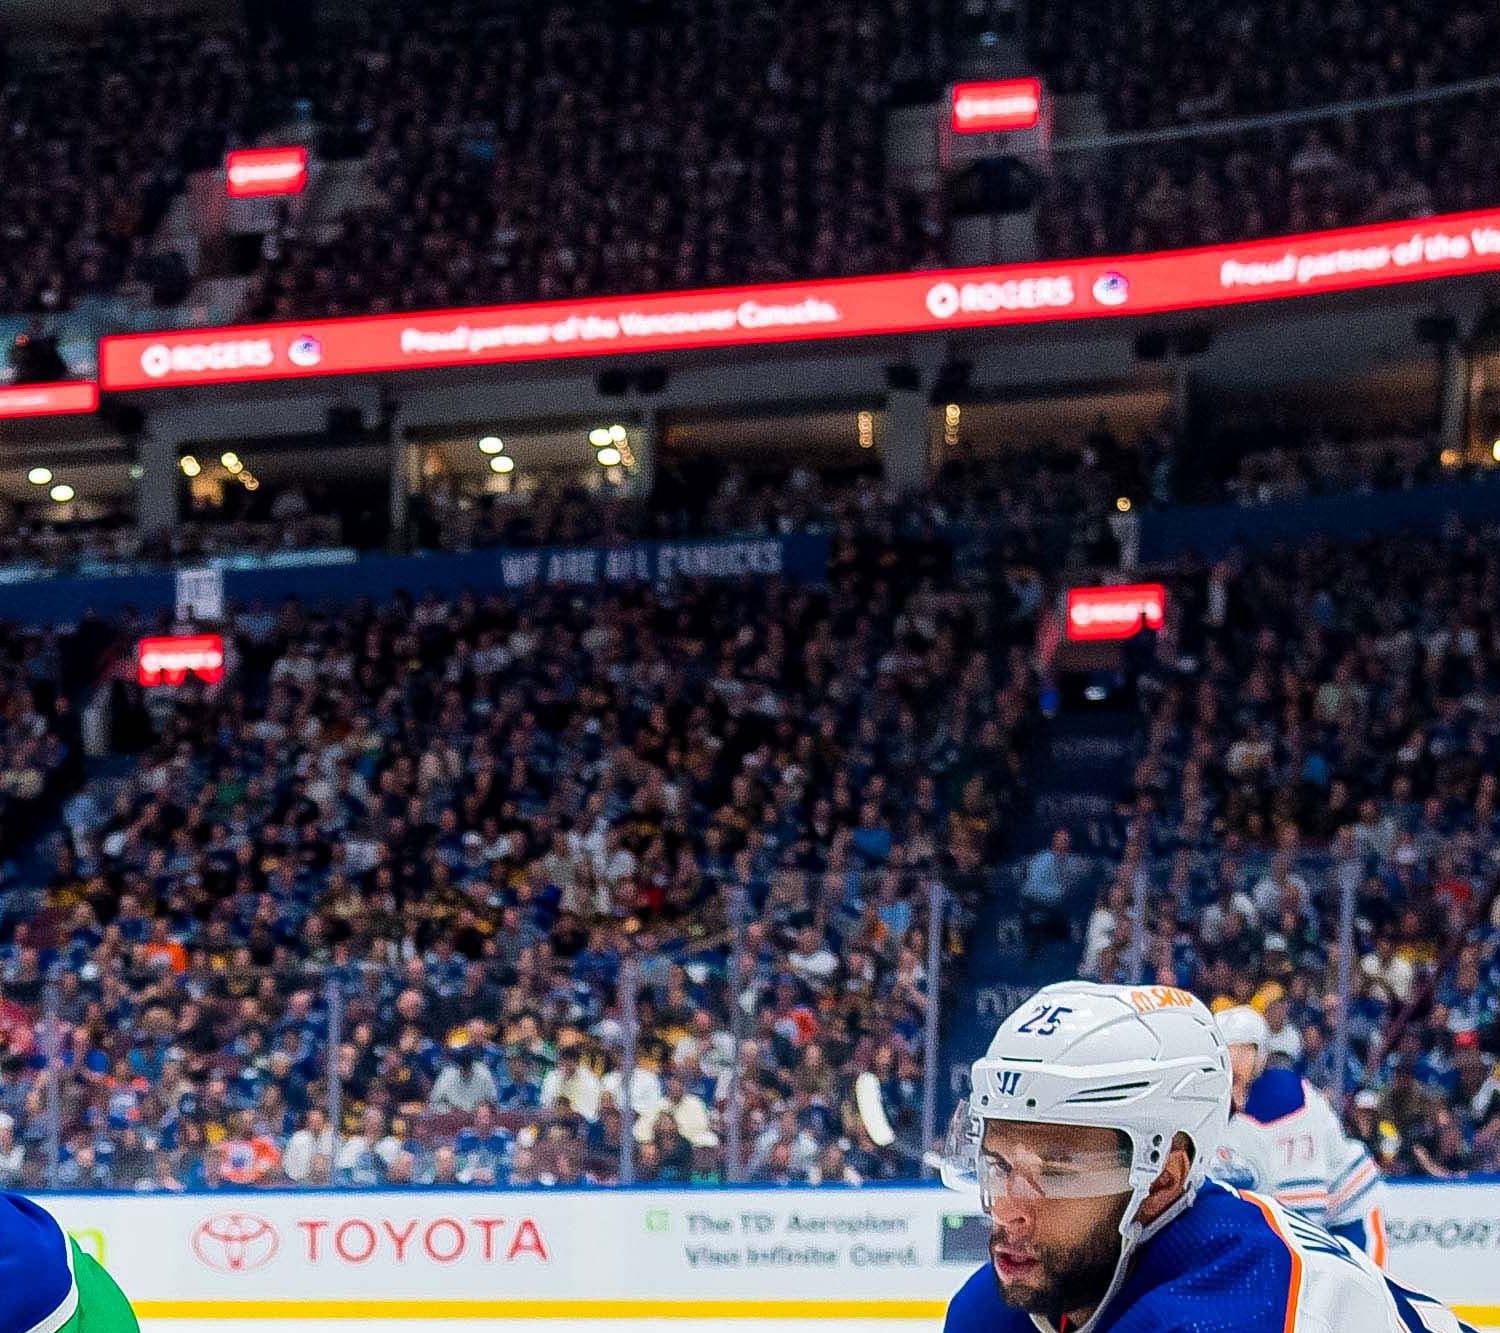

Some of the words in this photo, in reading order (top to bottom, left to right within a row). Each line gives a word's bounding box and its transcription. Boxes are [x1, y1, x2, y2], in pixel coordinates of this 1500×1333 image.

[1220, 252, 1297, 288] Proud
[1297, 246, 1392, 283] partner
[1393, 234, 1424, 265] of
[1424, 233, 1470, 260] the
[960, 276, 1074, 312] ROGERS
[170, 340, 272, 371] ROGERS
[1017, 1005, 1073, 1036] 25
[297, 1217, 549, 1264] TOYOTA
